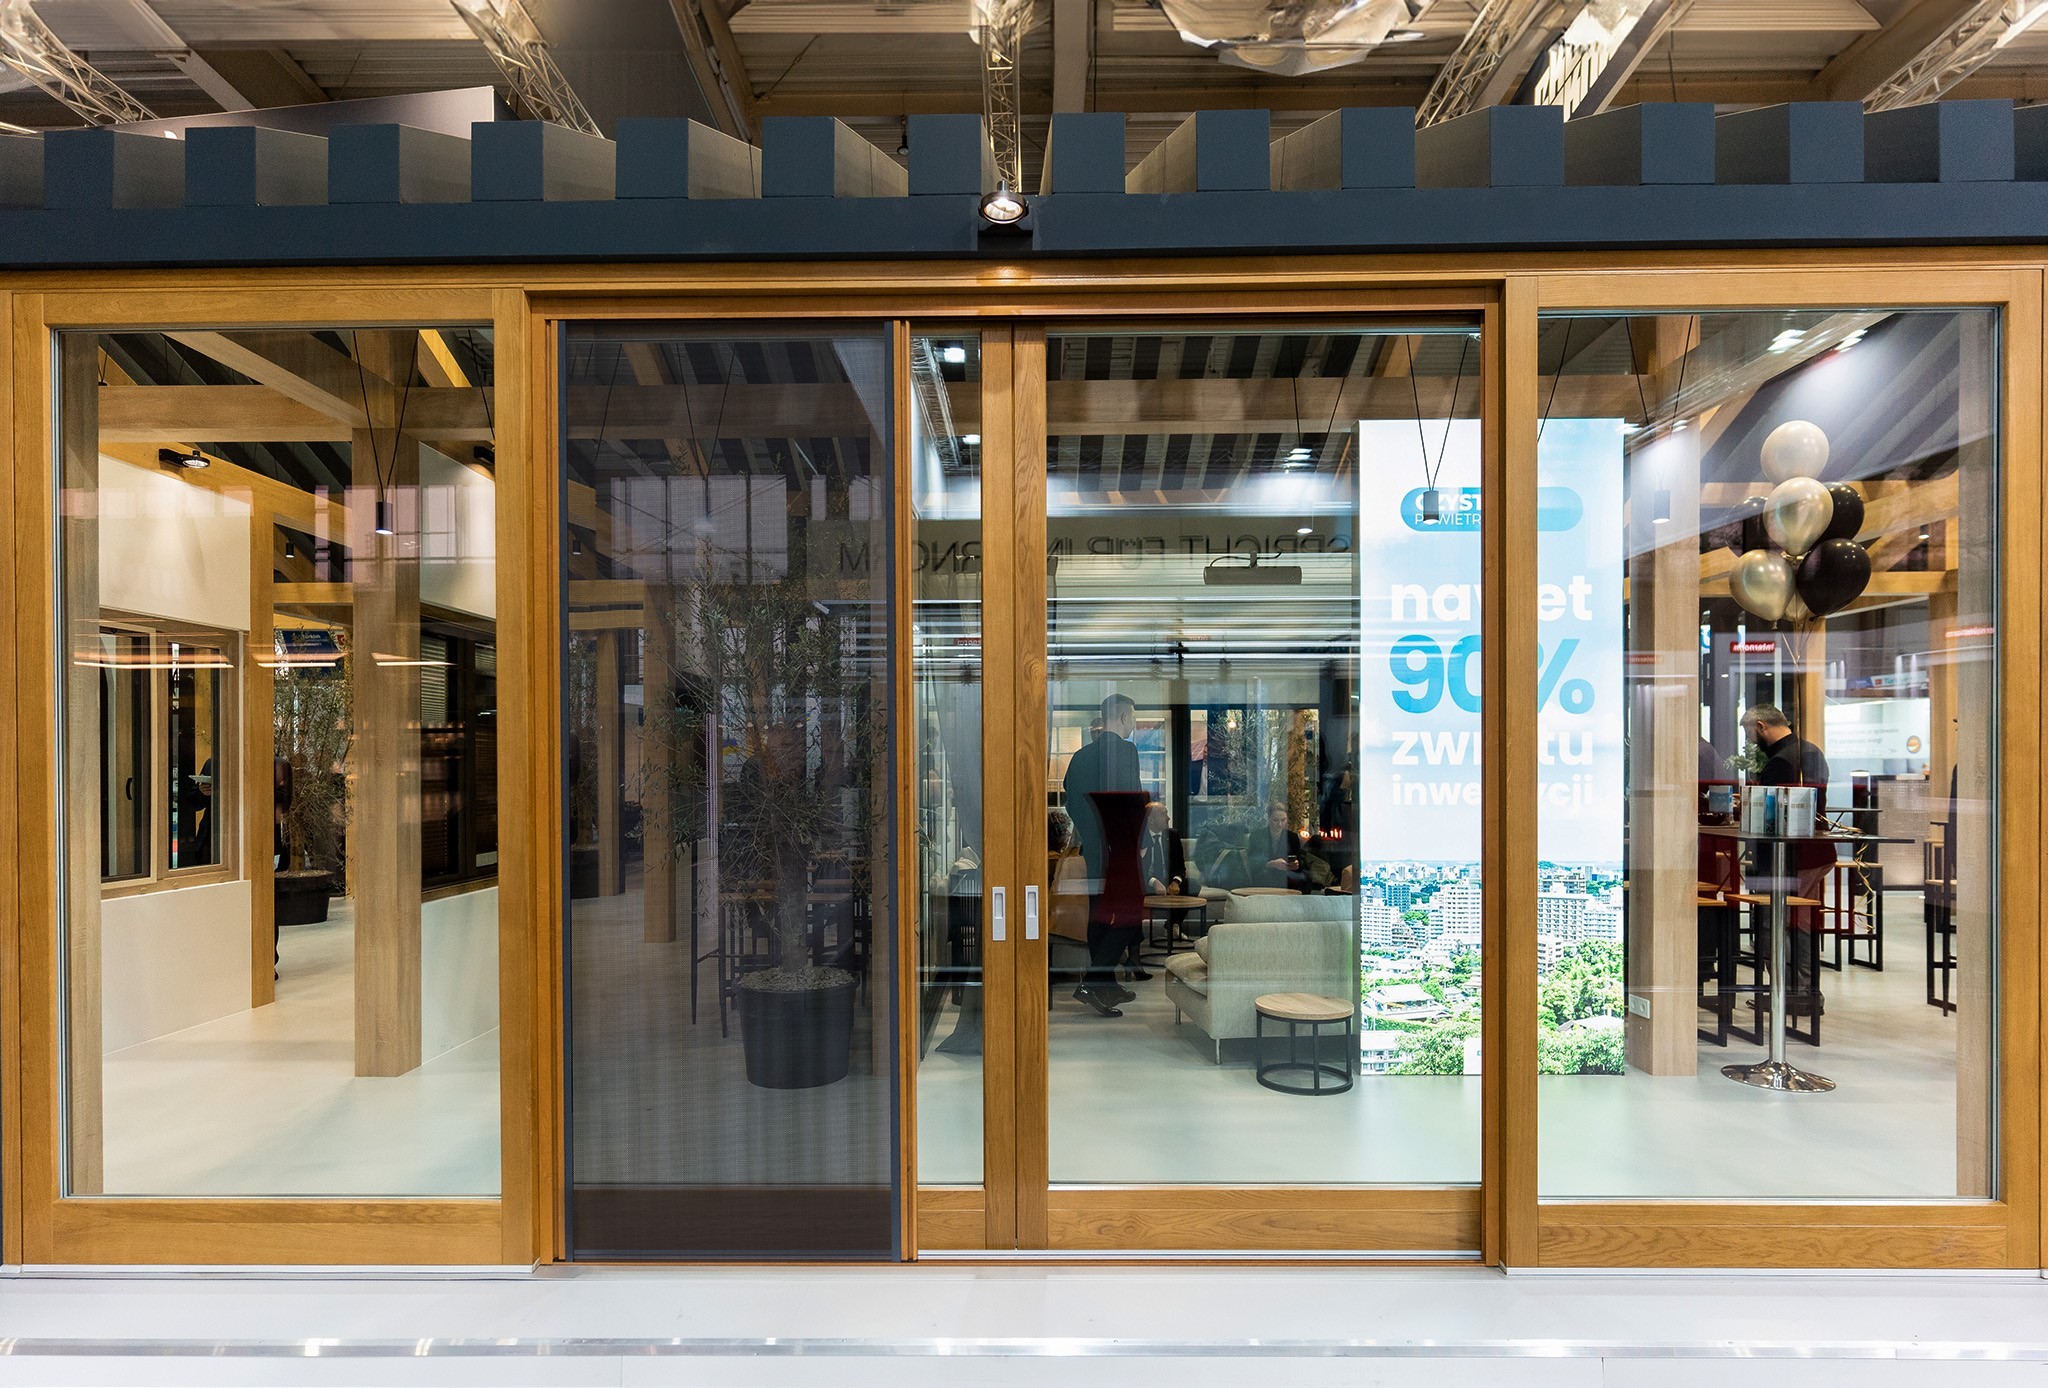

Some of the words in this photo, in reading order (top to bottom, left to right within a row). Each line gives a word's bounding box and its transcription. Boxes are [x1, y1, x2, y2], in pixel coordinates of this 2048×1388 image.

[1415, 494, 1481, 511] CZYST
[1415, 513, 1481, 525] PWIETR
[1391, 575, 1593, 622] naet
